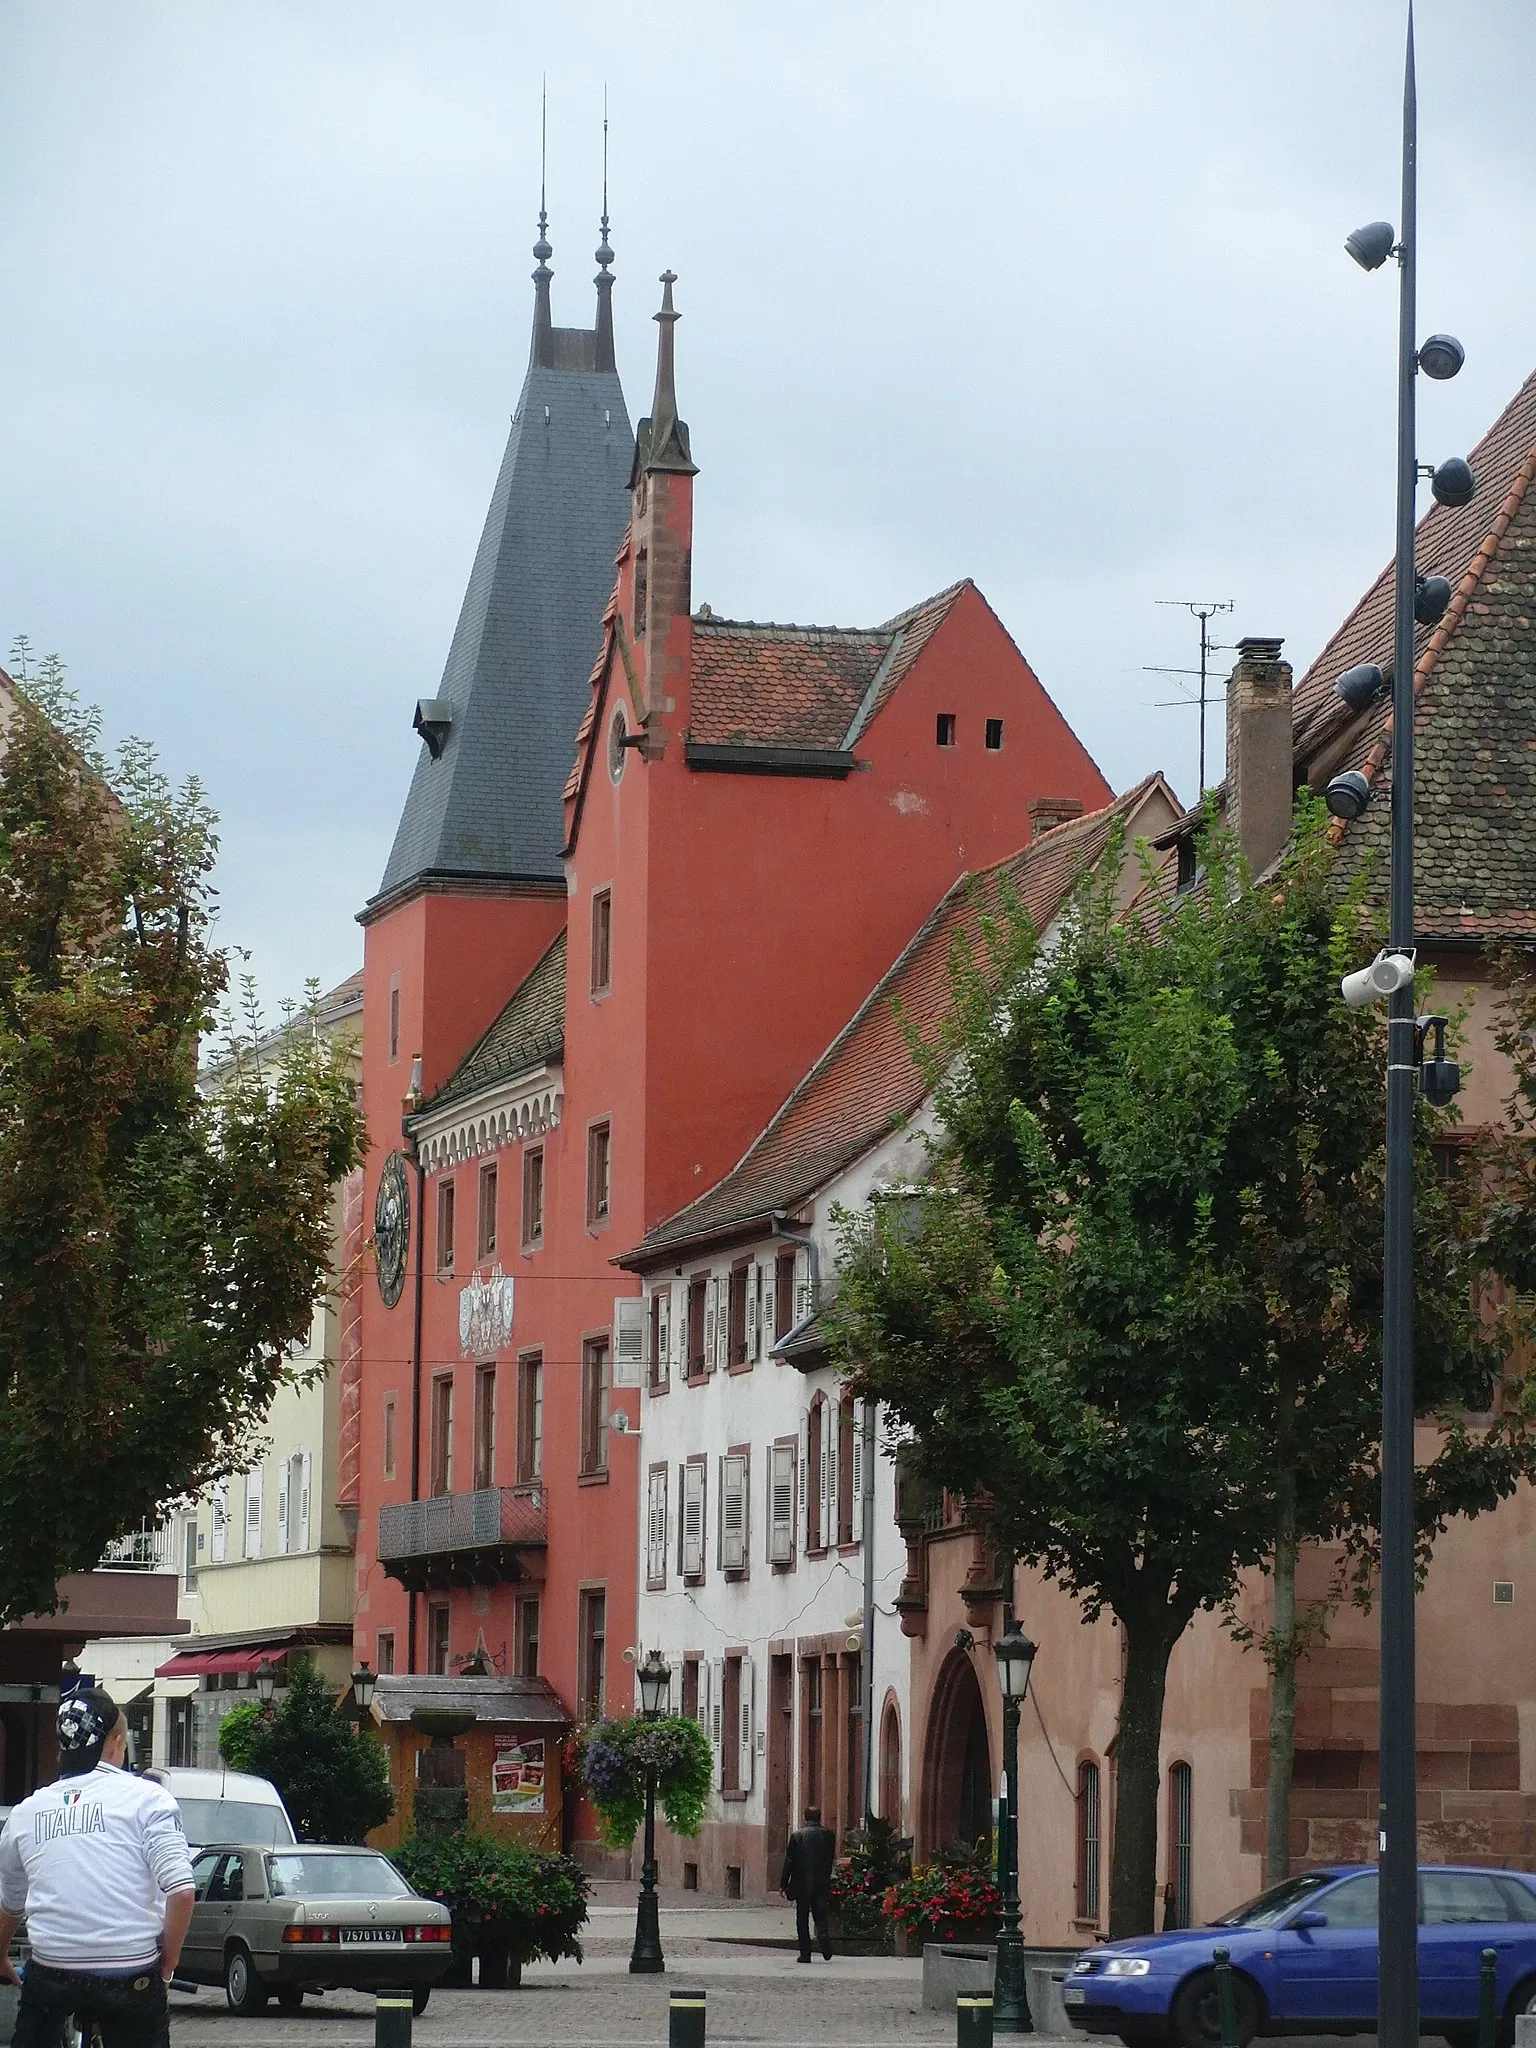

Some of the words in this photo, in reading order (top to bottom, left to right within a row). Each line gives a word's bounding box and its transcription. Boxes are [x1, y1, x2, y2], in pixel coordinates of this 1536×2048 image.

[35, 1802, 105, 1844] ITALIA
[345, 1930, 370, 1941] 7670
[371, 1930, 384, 1941] TX
[385, 1930, 397, 1941] 67
